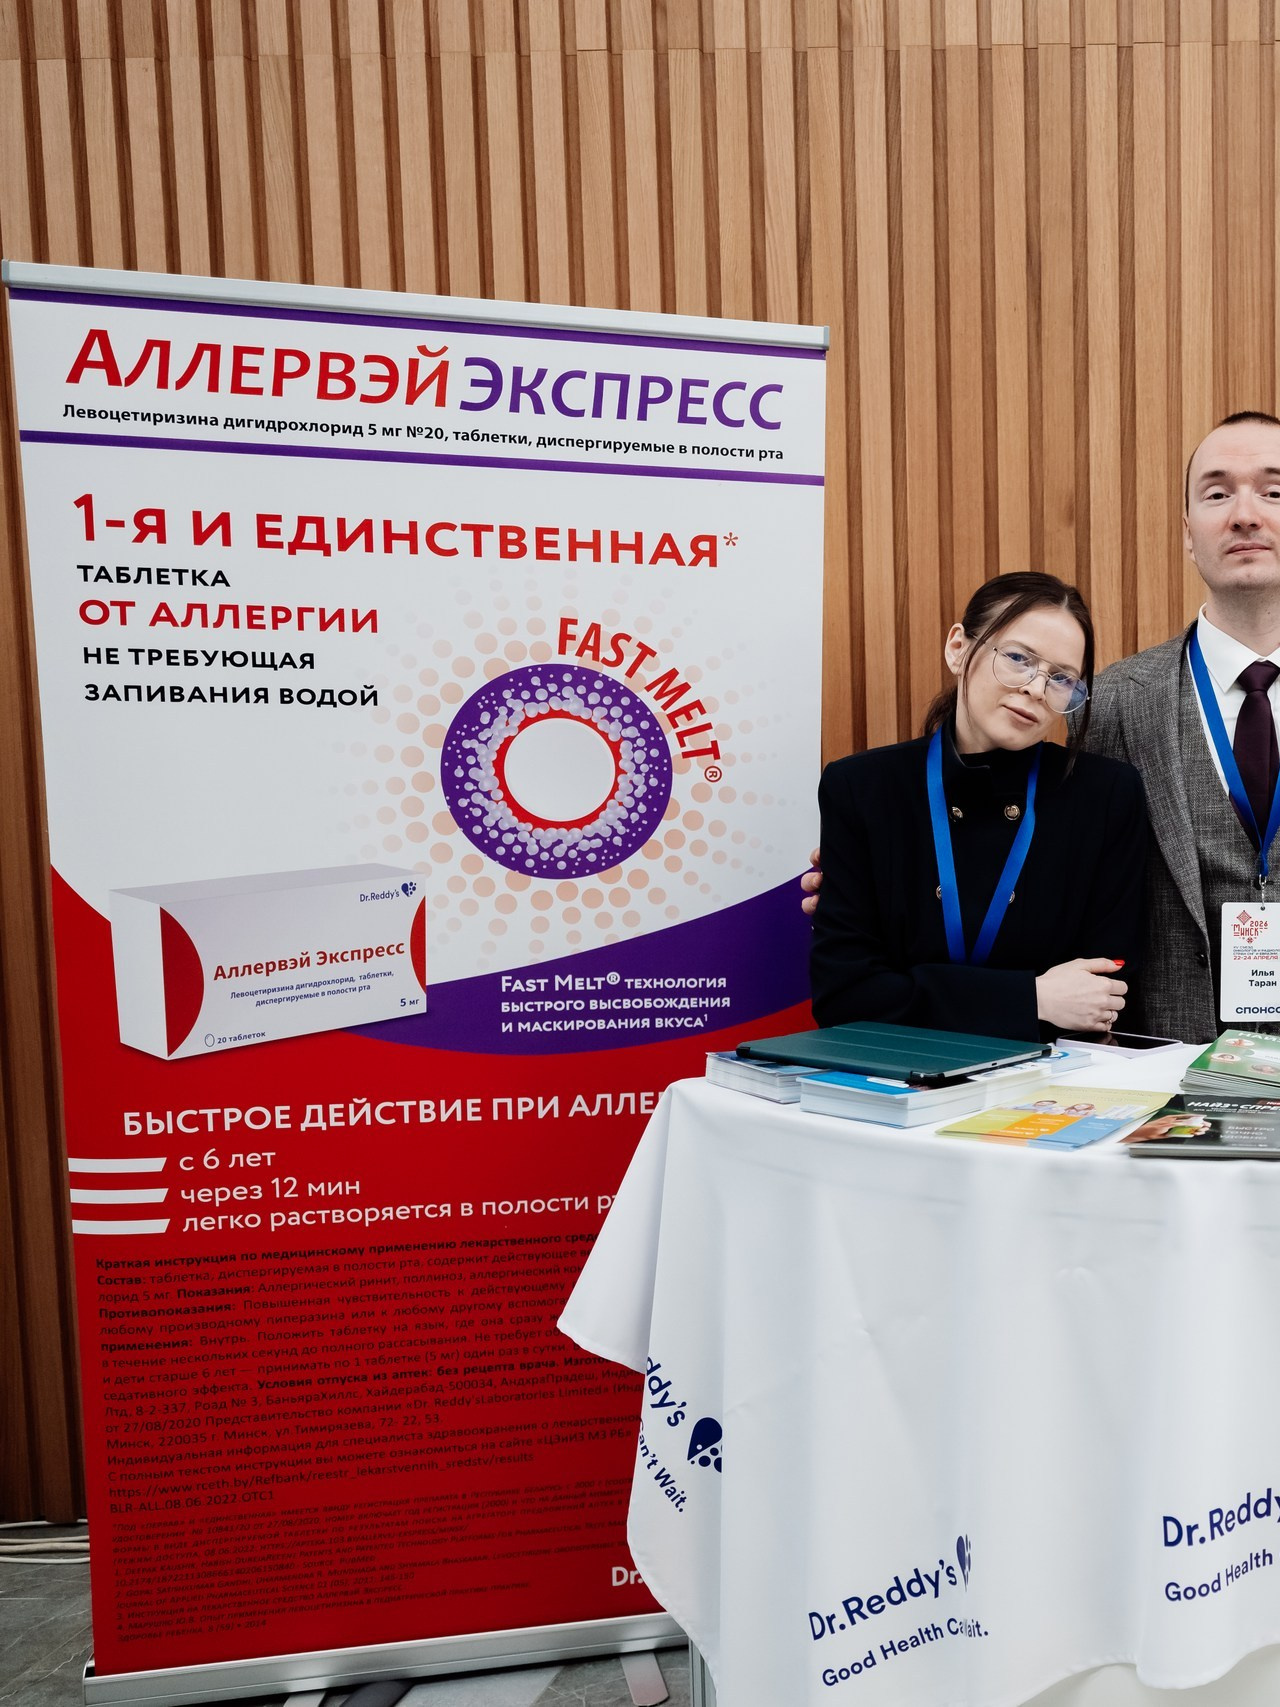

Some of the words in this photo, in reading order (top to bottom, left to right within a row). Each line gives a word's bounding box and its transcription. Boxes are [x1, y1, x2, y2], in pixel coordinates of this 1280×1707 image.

[64, 328, 450, 408] АЛЛЕРВЭЙ
[458, 356, 784, 431] ЭКСПРЕСС
[62, 403, 219, 427] Левоцетиризина
[222, 416, 364, 438] дигидрохлорид
[367, 422, 377, 436] 5
[381, 426, 402, 438] мг
[406, 424, 449, 442] №20,
[452, 428, 532, 447] таблетки,
[535, 435, 675, 455] диспергируемые
[678, 444, 688, 455] в
[691, 445, 754, 458] полости
[758, 449, 784, 462] рта
[72, 492, 167, 545] 1-Я
[191, 509, 232, 548] И
[76, 564, 231, 588] ТАБЛЕТКА
[78, 598, 136, 627] ОТ
[148, 601, 378, 634] АЛЛЕРГИИ
[82, 646, 120, 666] НЕ
[126, 647, 314, 672] ТРЕБУЮЩАЯ
[558, 617, 657, 679] FAST
[84, 683, 269, 705] ЗАПИВАНИЯ
[278, 684, 378, 709] ВОДОЙ
[358, 887, 401, 904] Dr.Reddy's
[212, 950, 311, 982] Аллервэй
[315, 942, 405, 967] Экспресс
[1251, 969, 1275, 977] Илья
[229, 984, 294, 1000] Левоцетиризина
[294, 975, 356, 992] дигидрохлорид,
[358, 970, 394, 981] таблетки,
[254, 991, 320, 1008] диспергируемые
[326, 986, 357, 996] полости
[357, 984, 371, 994] рта
[500, 975, 549, 993] FAST
[623, 976, 727, 990] ТЕХНОЛОГИЯ
[1248, 979, 1277, 988] Таран
[399, 997, 407, 1008] 5
[408, 998, 420, 1006] мг
[500, 999, 585, 1013] БЫСТРОГО
[588, 996, 730, 1011] ВЫСВОБОЖДЕНИЯ
[217, 1035, 228, 1046] 20
[229, 1030, 267, 1044] таблеток
[500, 1021, 513, 1034] И
[517, 1017, 650, 1033] МАСКИРОВАНИЯ
[123, 1104, 292, 1136] БЫСТРОЕ
[299, 1096, 482, 1132] ДЕЙСТВИЕ
[492, 1095, 559, 1121] ПРИ
[567, 1090, 665, 1118] АЛЛЕ
[178, 1155, 194, 1172] с
[202, 1147, 220, 1170] 6
[228, 1151, 276, 1169] лет
[180, 1184, 263, 1208] через
[270, 1176, 299, 1199] 12
[307, 1180, 360, 1197] мин
[182, 1212, 262, 1233] легко
[269, 1202, 451, 1233] растворяется
[460, 1201, 474, 1217] в
[481, 1195, 589, 1216] полости
[597, 1194, 616, 1215] р
[95, 1257, 151, 1271] Краткая
[153, 1253, 237, 1268] инструкция
[239, 1251, 258, 1262] по
[260, 1246, 365, 1262] медицинскому
[368, 1239, 457, 1256] применению
[458, 1234, 562, 1250] лекарственного
[653, 1466, 687, 1513] Wait.
[1164, 1573, 1222, 1603] Good
[1225, 1547, 1274, 1588] Health
[808, 1558, 958, 1641] Dr.Reddy's
[822, 1651, 877, 1687] Good
[880, 1623, 944, 1660] Health
